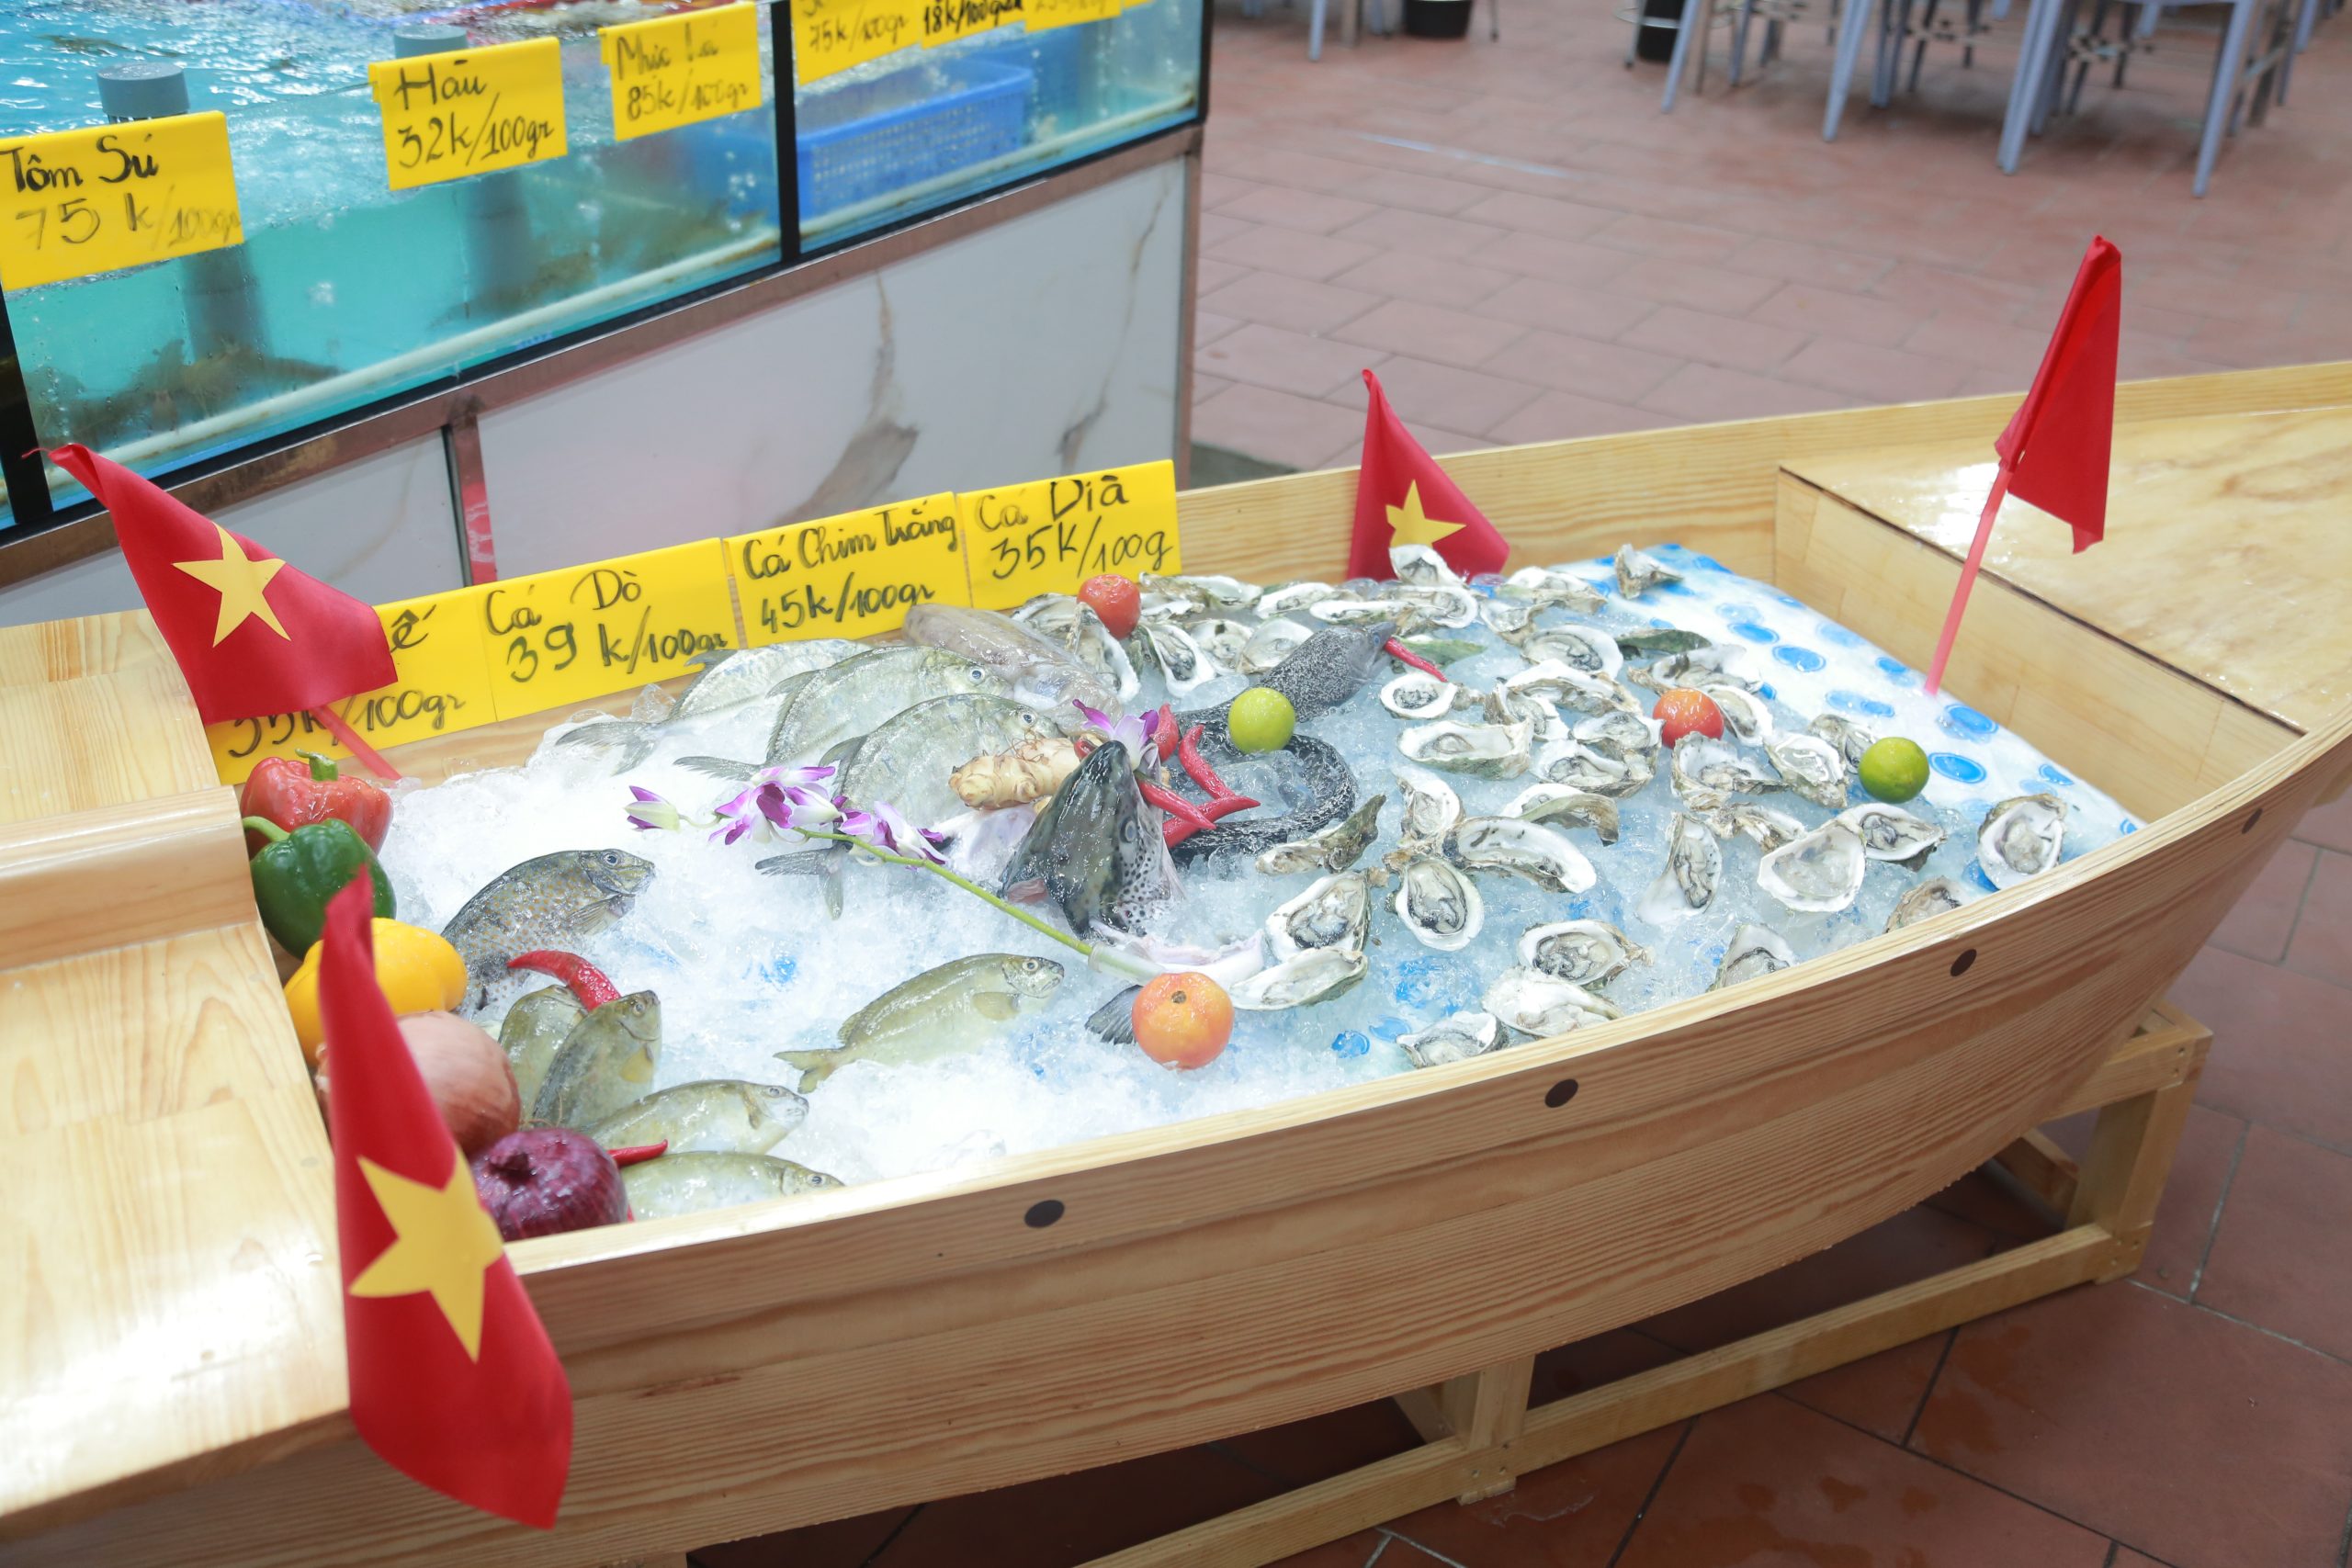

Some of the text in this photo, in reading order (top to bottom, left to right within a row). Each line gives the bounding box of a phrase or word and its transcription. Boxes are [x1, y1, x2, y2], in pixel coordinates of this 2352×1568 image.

[0, 133, 159, 193] Tôm Sú
[742, 535, 791, 580] Cá
[798, 525, 876, 569] Chim
[486, 568, 642, 636] Cá Dò
